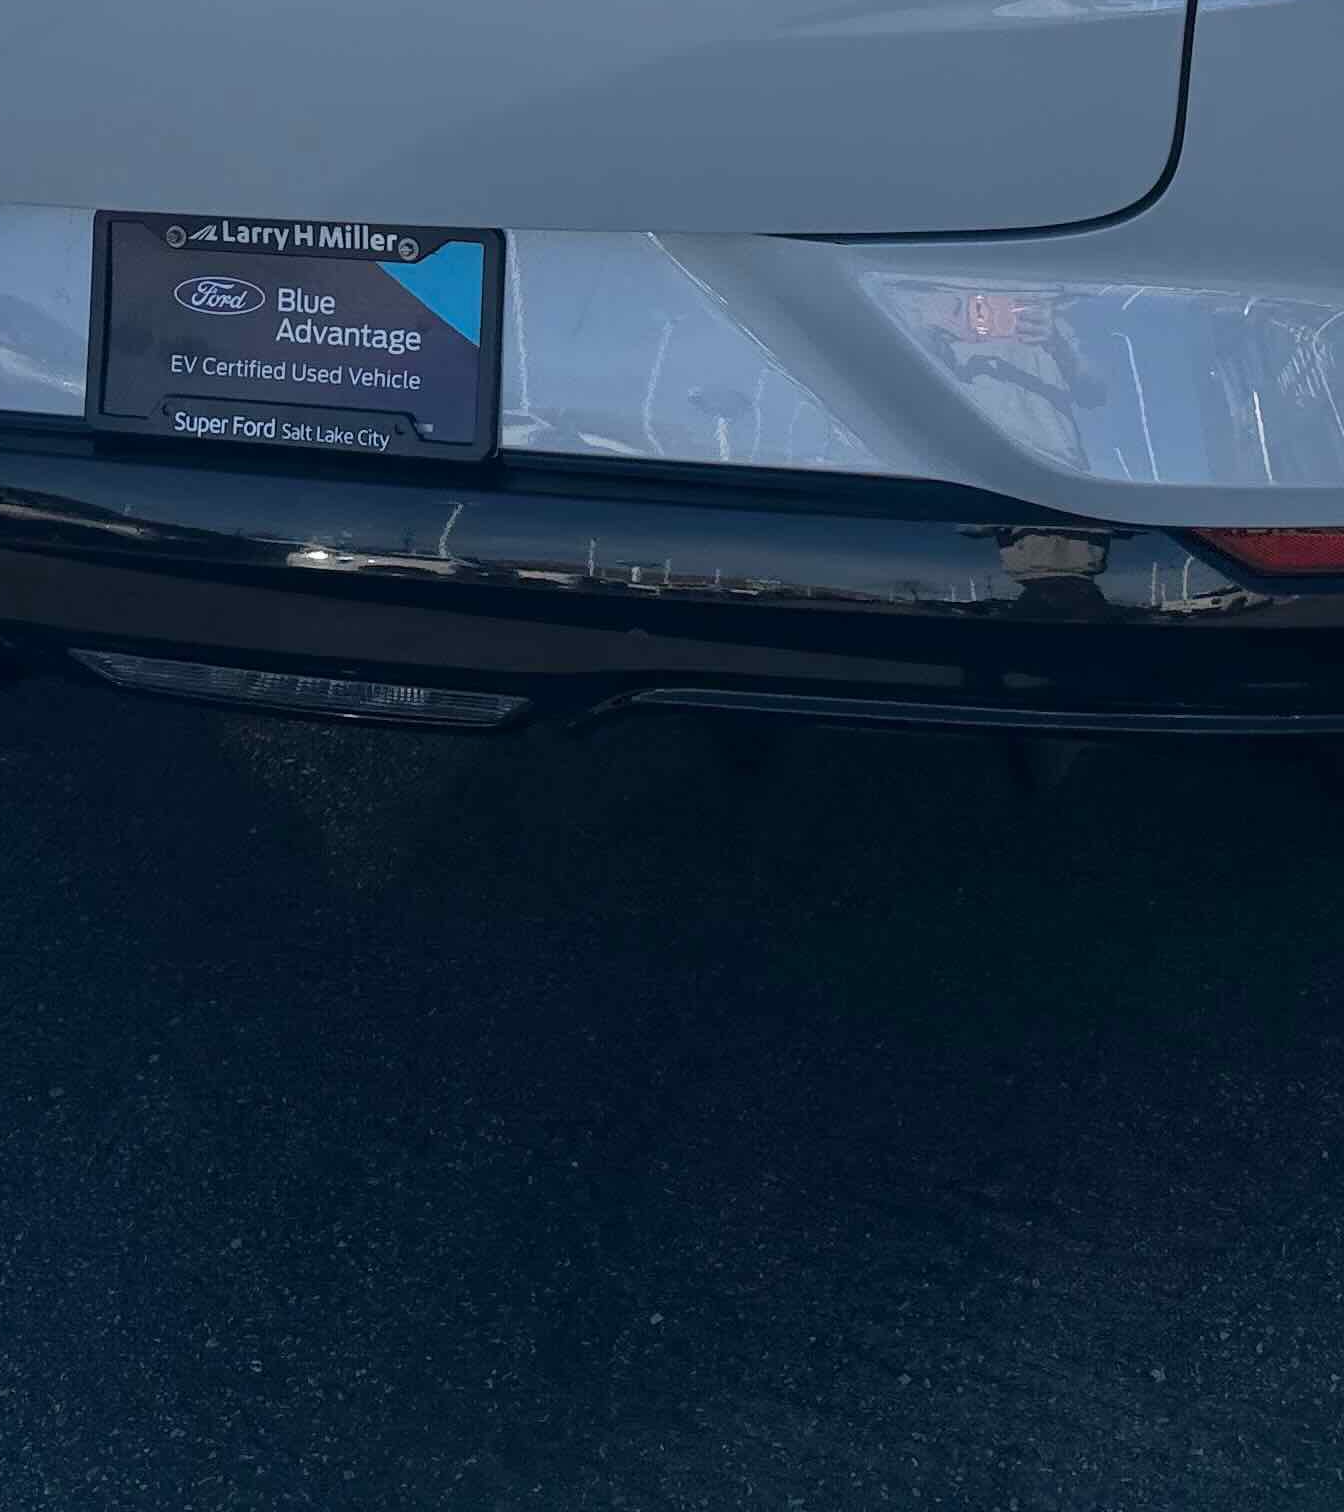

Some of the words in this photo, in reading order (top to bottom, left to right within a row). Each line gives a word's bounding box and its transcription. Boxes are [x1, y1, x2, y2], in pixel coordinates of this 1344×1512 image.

[222, 220, 290, 251] Larry
[294, 224, 314, 248] H
[319, 225, 398, 252] Miller
[191, 280, 248, 310] Ford
[277, 287, 336, 315] Blue
[275, 317, 422, 355] Advantage
[171, 354, 198, 373] EV
[203, 357, 286, 381] Certified
[292, 364, 343, 385] Used
[348, 367, 422, 390] Vehicle
[174, 411, 228, 437] Super
[233, 416, 276, 438] Ford
[281, 423, 313, 441] Salt
[317, 427, 353, 444] Lake
[357, 429, 390, 451] City
